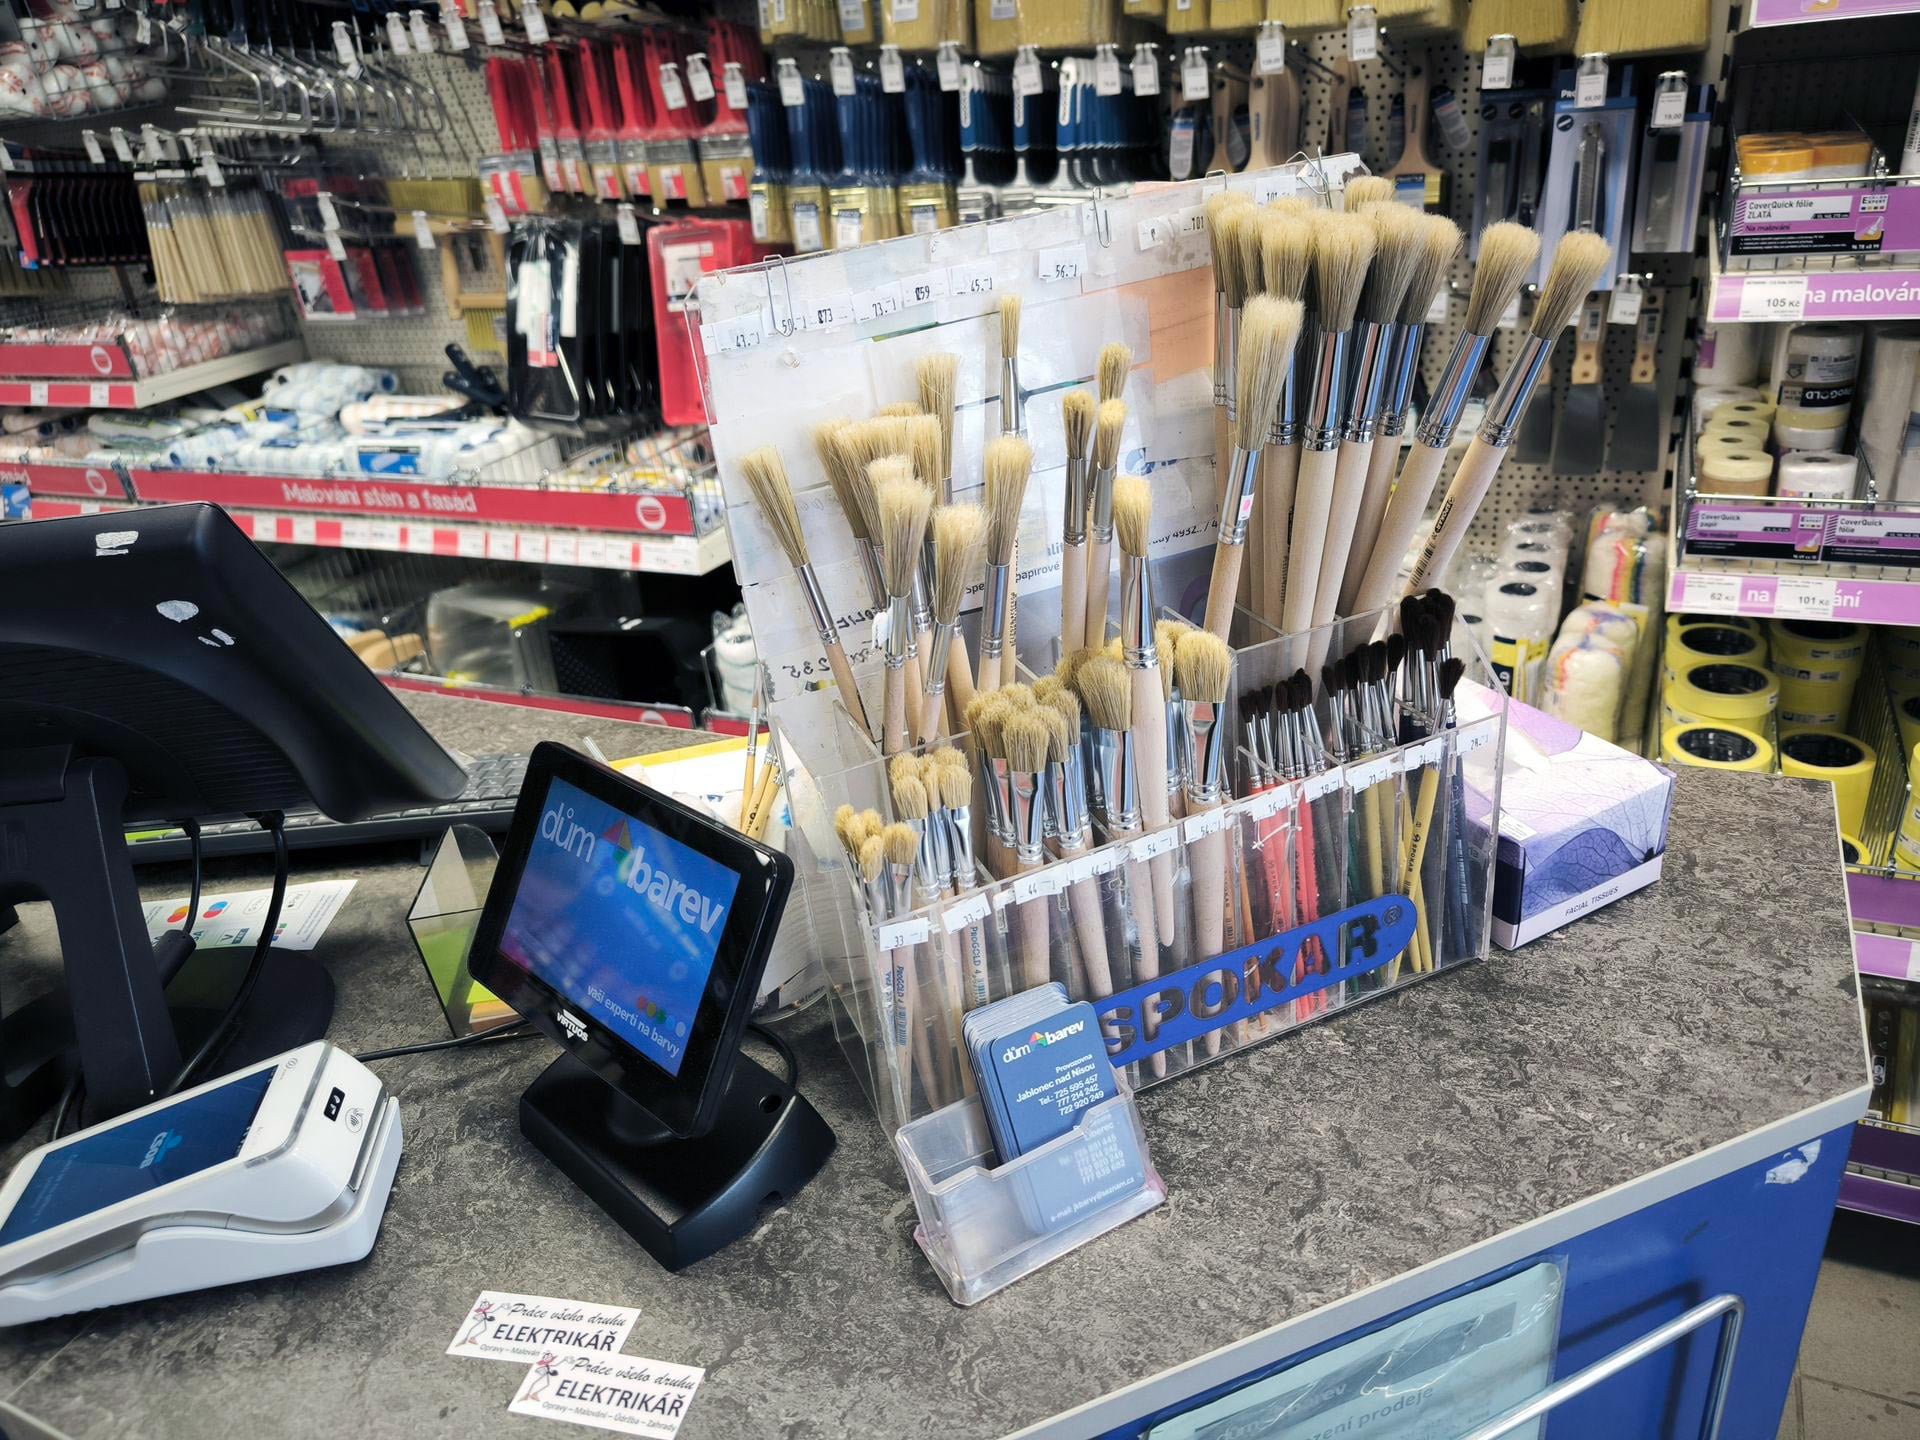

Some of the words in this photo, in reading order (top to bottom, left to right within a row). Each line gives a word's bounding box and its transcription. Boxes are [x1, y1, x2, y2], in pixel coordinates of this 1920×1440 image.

[1747, 210, 1772, 220] ZLATÁ
[1748, 200, 1794, 210] CoverQuick
[1796, 200, 1814, 208] fólie
[1766, 298, 1786, 307] 105
[407, 492, 421, 509] a
[1700, 513, 1741, 521] CoverQuick
[1839, 518, 1883, 527] CoverQuick
[1709, 592, 1722, 601] 62
[1746, 588, 1770, 604] na
[1798, 596, 1817, 606] 101
[541, 802, 597, 864] dům
[626, 845, 725, 935] barev
[1564, 900, 1589, 917] FACIAL
[1590, 886, 1619, 904] TISSUES
[970, 926, 981, 967] PROGOLD
[1099, 913, 1382, 1058] SPOKAR
[556, 1012, 589, 1042] VIRTUOS
[587, 984, 605, 1002] vaši
[604, 994, 640, 1026] experti
[638, 1021, 652, 1037] na
[651, 1028, 680, 1058] barvy
[1002, 1042, 1031, 1064] dům
[1045, 1020, 1084, 1045] barev
[1055, 1053, 1093, 1074] Provozovna
[1016, 1080, 1055, 1103] Jablonec
[1055, 1073, 1071, 1086] nad
[1071, 1063, 1096, 1078] Nisou
[1053, 1086, 1069, 1099] 725
[1084, 1073, 1098, 1087] 457
[1056, 1095, 1071, 1108] 777
[1084, 1083, 1099, 1096] 242
[1059, 1104, 1075, 1116] 722
[1074, 1098, 1089, 1111] 920
[508, 1302, 548, 1320] Práce
[549, 1308, 584, 1322] všeho
[587, 1311, 628, 1327] druhu
[479, 1343, 504, 1354] Opravy
[492, 1323, 617, 1351] ELEKTRIKÁŘ
[570, 1356, 611, 1376] Práce
[615, 1365, 652, 1384] všeho
[654, 1369, 697, 1391] druhu
[555, 1379, 685, 1418] ELEKTRIKÁŘ
[1358, 1385, 1434, 1431] prodeje
[541, 1400, 569, 1414] Opravy
[574, 1406, 609, 1420] Malování
[646, 1418, 677, 1433] Zahrady
